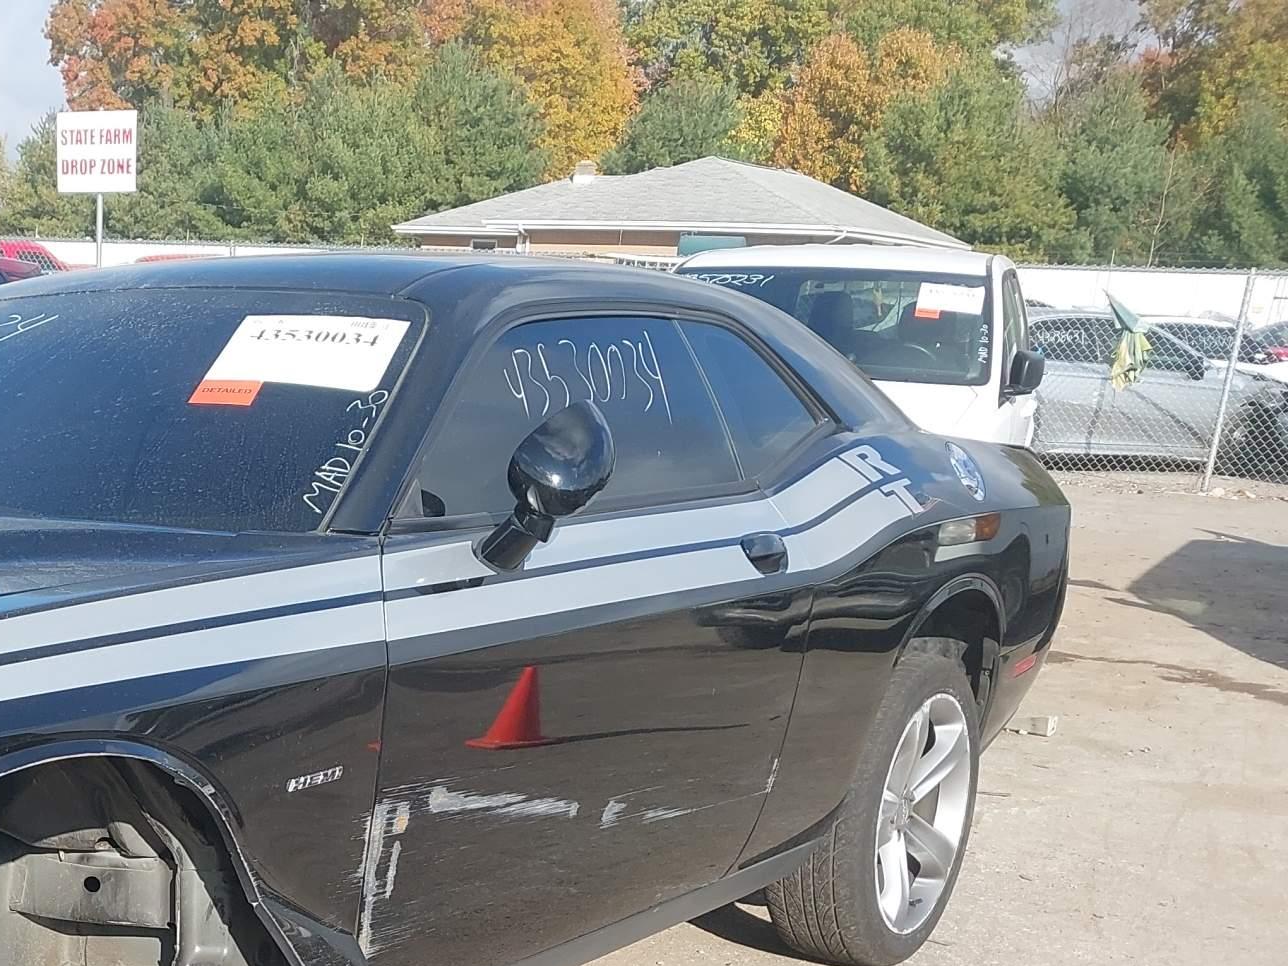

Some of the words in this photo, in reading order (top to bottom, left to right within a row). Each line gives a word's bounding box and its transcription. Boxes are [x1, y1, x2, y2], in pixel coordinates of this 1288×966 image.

[60, 128, 96, 146] STATE
[99, 127, 133, 145] FARM
[61, 158, 97, 175] DROP
[100, 157, 133, 175] ZONE
[250, 328, 380, 347] 43530034
[503, 330, 673, 425] 43530034
[201, 386, 253, 394] DETAILED
[303, 457, 351, 514] MAD
[335, 390, 389, 452] 10-30
